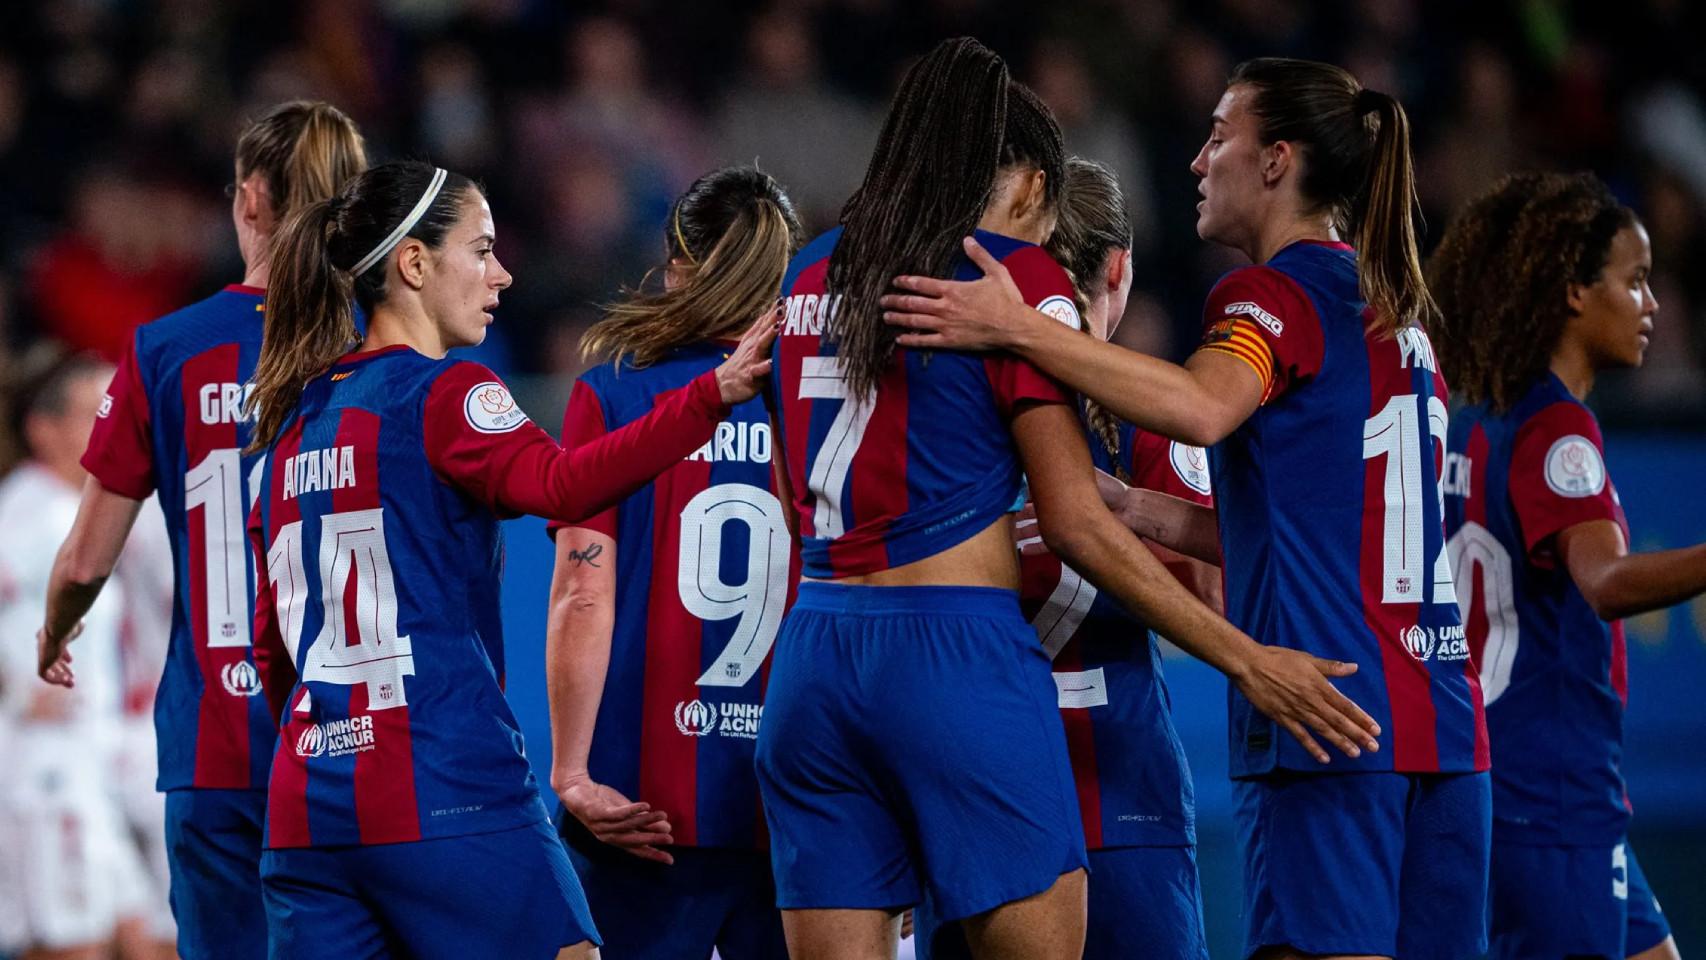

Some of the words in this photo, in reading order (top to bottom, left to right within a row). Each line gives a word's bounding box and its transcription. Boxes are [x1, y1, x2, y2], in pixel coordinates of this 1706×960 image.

[283, 445, 357, 501] AITANA
[798, 356, 877, 540] 7
[266, 507, 416, 711] 14
[678, 483, 791, 688] 9
[326, 715, 373, 737] UNHCR
[328, 729, 375, 751] ACNUR
